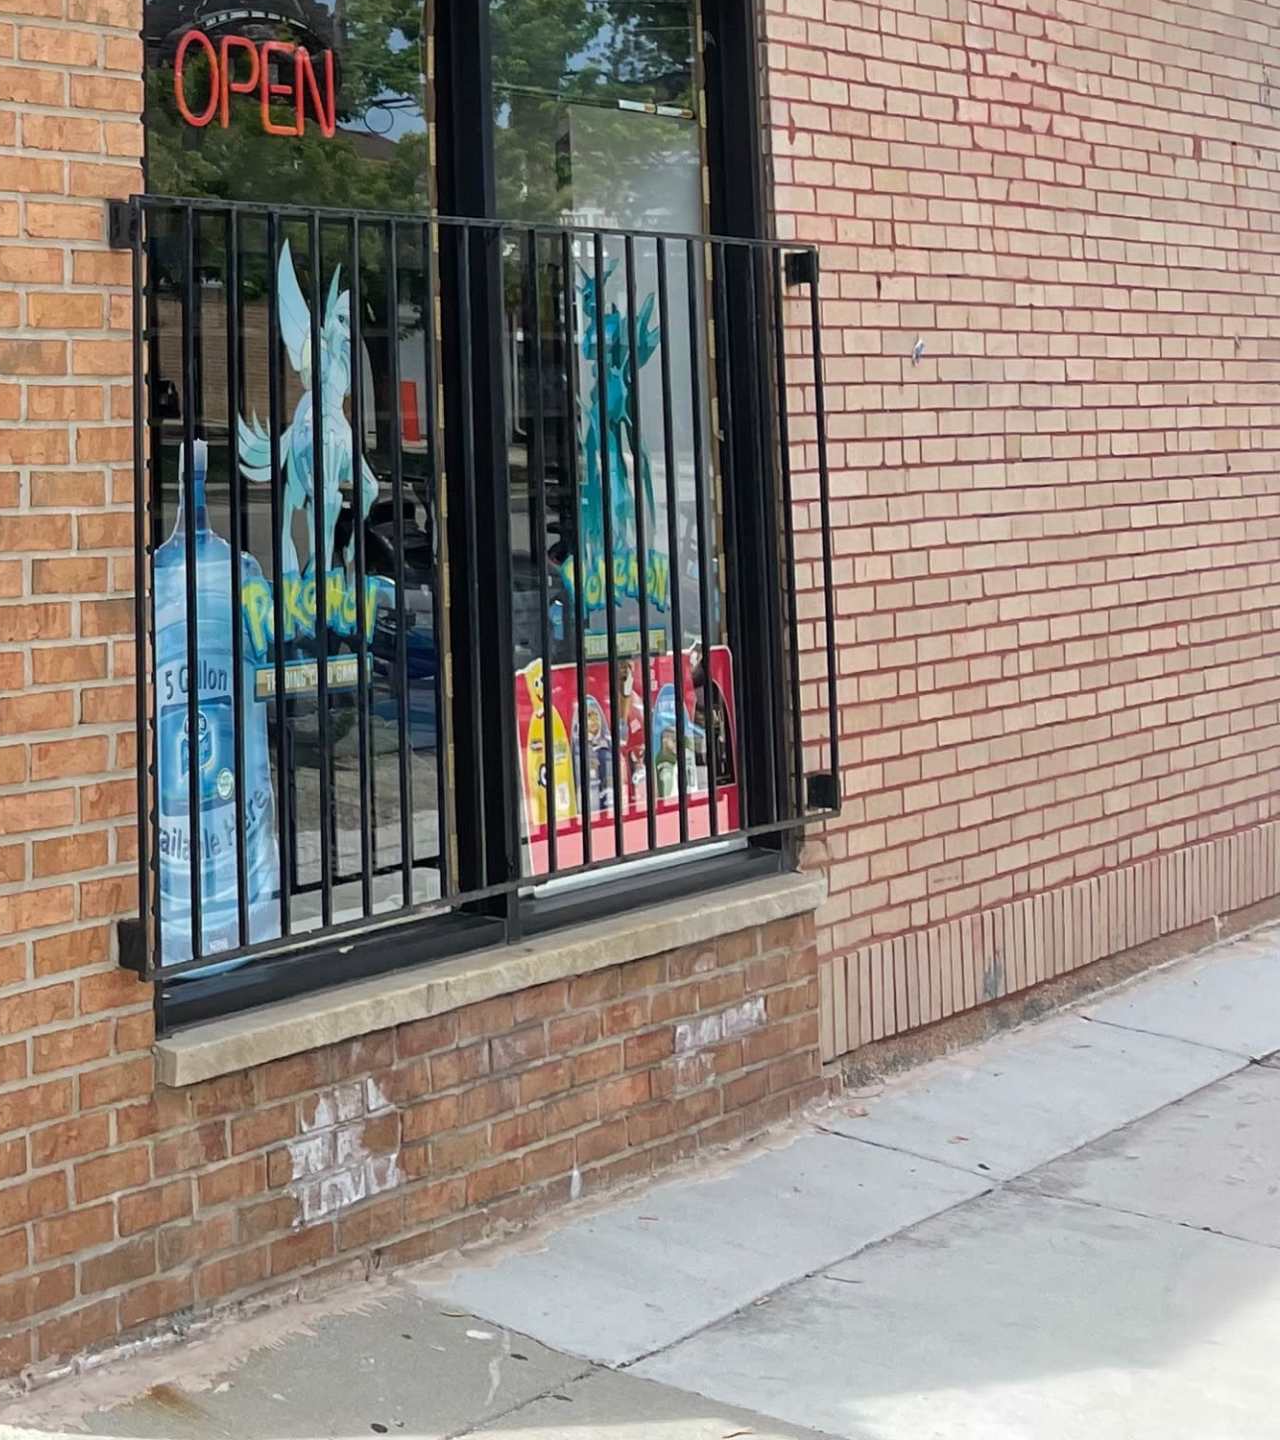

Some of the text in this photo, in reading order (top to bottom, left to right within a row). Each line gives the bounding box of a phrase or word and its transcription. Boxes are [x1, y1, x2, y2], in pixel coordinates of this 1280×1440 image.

[175, 30, 336, 138] OPEN
[166, 660, 227, 700] 5 Gllon
